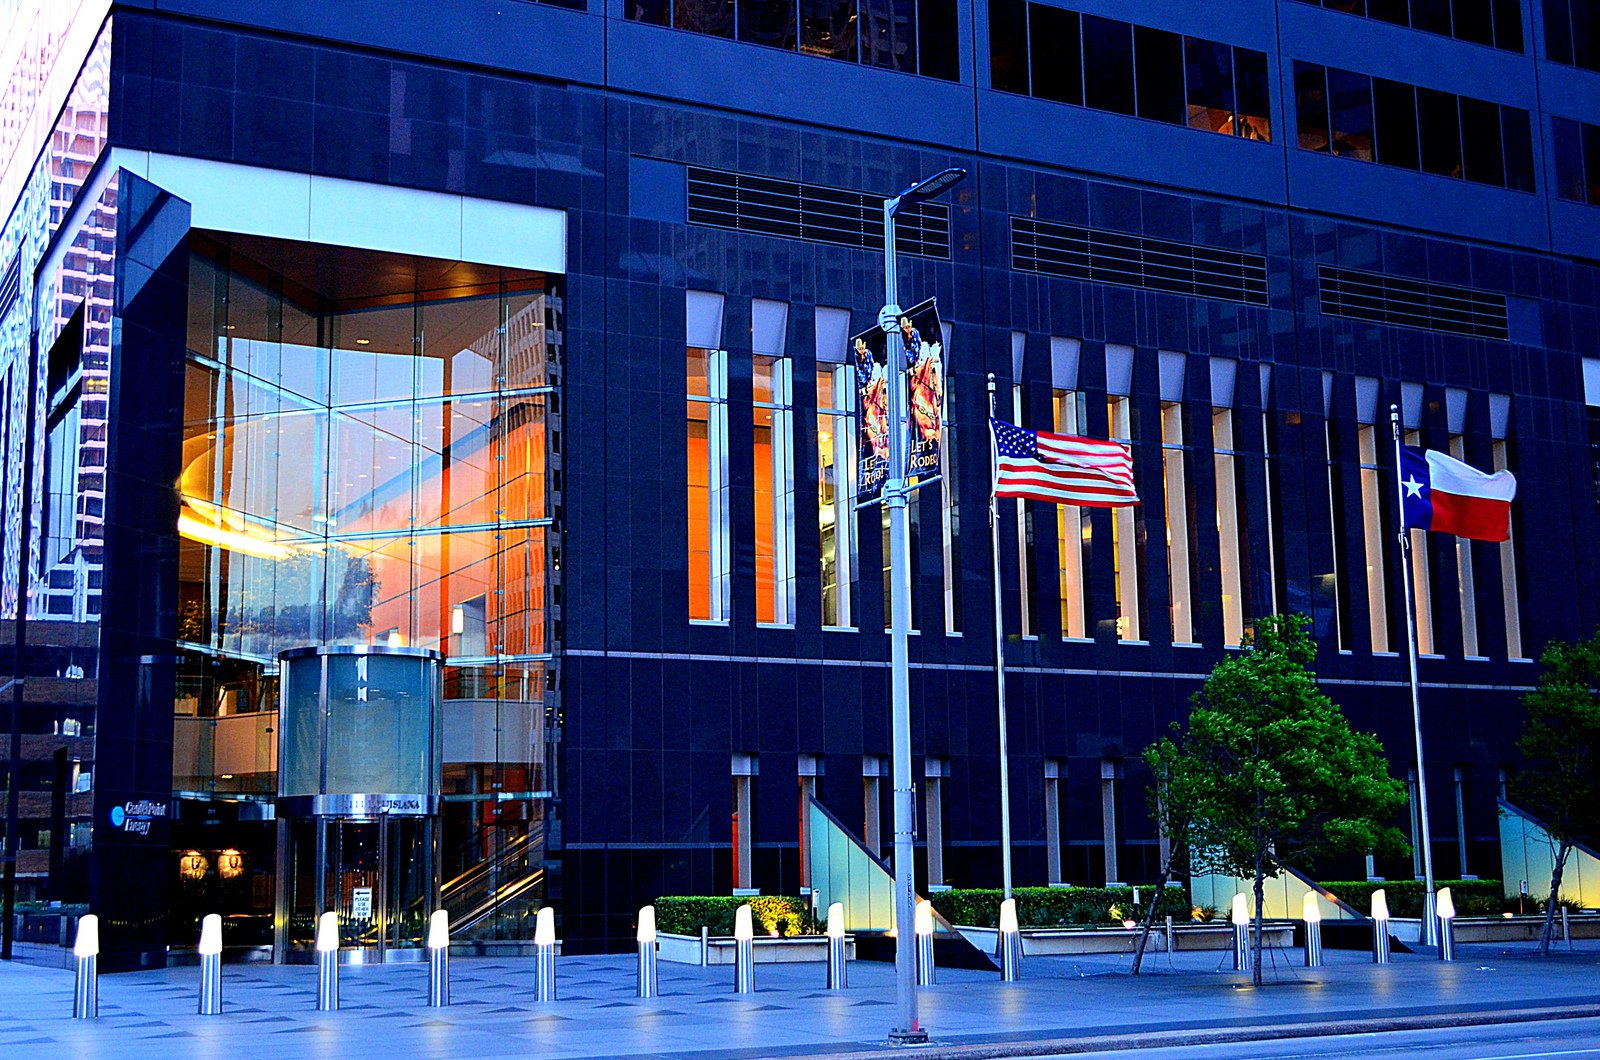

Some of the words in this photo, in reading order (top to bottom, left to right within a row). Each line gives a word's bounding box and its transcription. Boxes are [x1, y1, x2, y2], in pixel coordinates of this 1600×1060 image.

[910, 437, 934, 454] LET'S
[125, 801, 167, 816] CenterPoint
[124, 818, 151, 836] Energy
